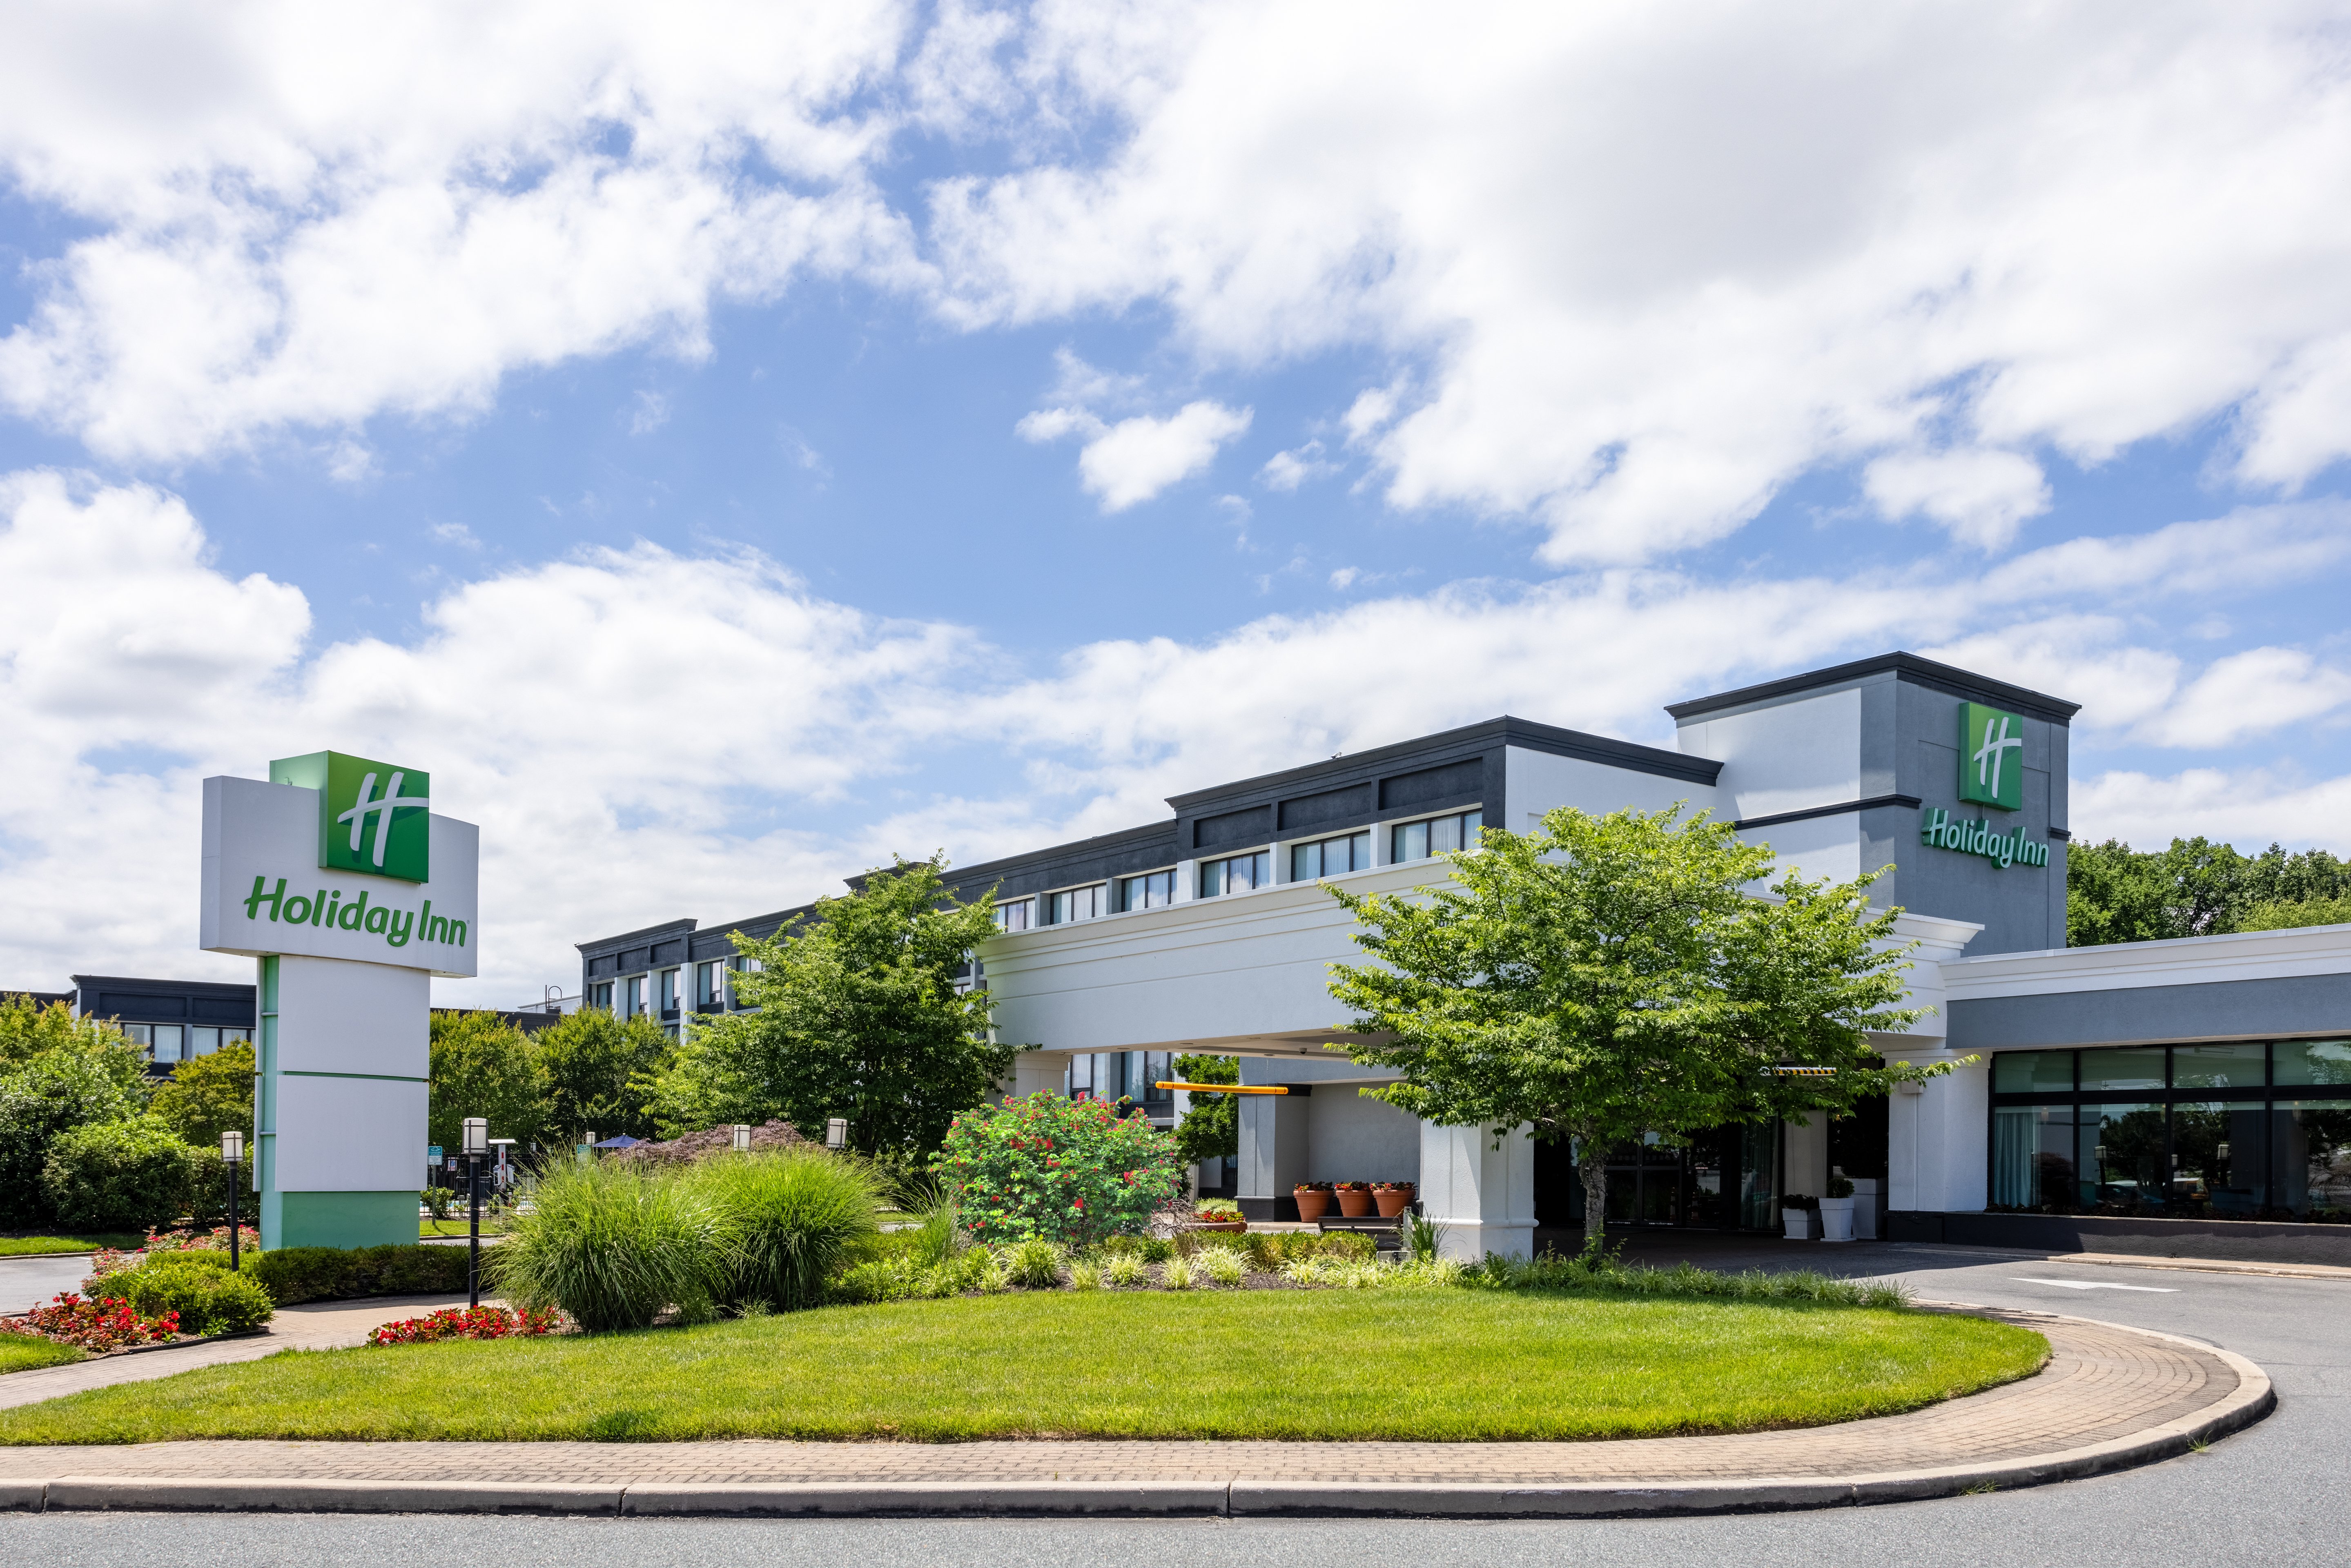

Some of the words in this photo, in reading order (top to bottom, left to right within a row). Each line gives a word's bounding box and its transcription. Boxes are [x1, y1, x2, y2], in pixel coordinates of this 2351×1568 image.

[1927, 807, 2015, 869] Holiday
[2017, 826, 2049, 867] Inn
[244, 875, 414, 947] Holiday
[418, 900, 467, 947] Inn
